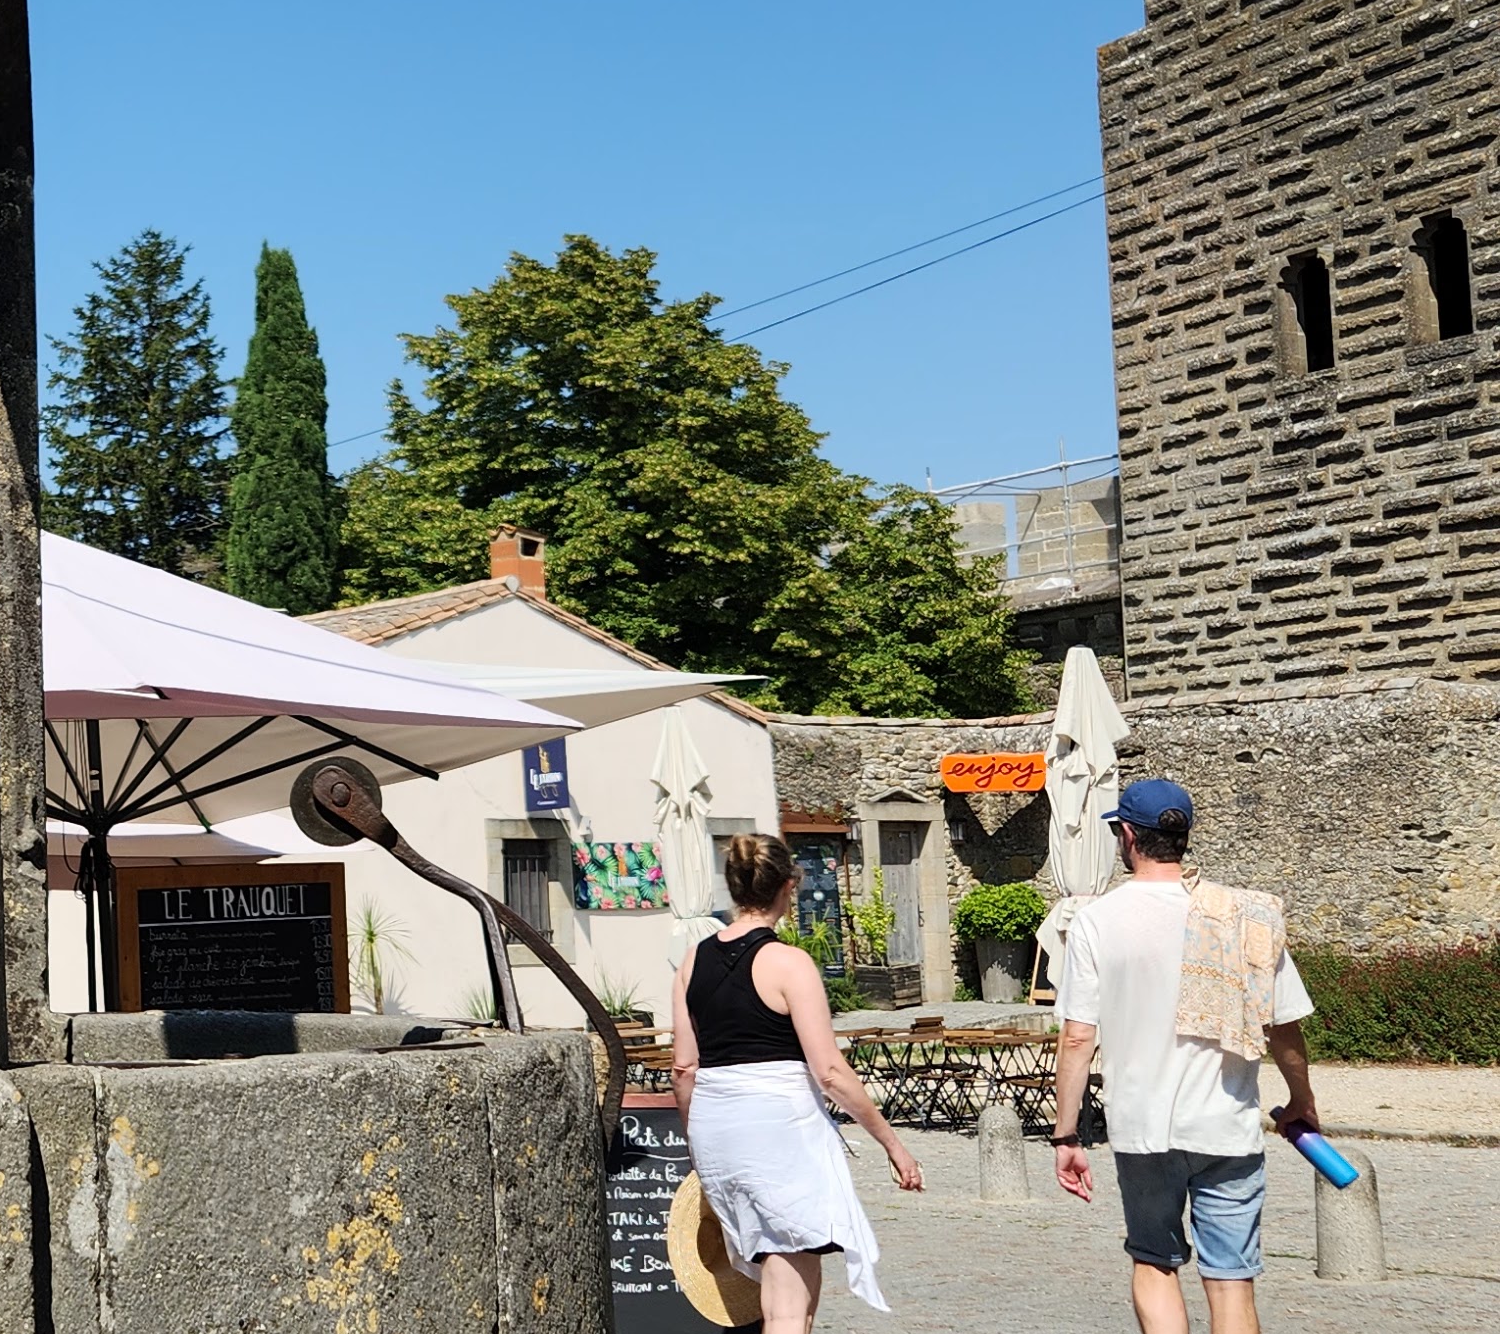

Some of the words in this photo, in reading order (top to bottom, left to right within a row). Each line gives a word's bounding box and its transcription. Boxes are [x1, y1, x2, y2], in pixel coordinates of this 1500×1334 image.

[945, 757, 1043, 788] enjoy
[162, 889, 193, 919] LE
[203, 884, 309, 919] TRAUQUET
[620, 1115, 660, 1147] Plats
[663, 1130, 687, 1147] du
[606, 1207, 643, 1226] TAKI
